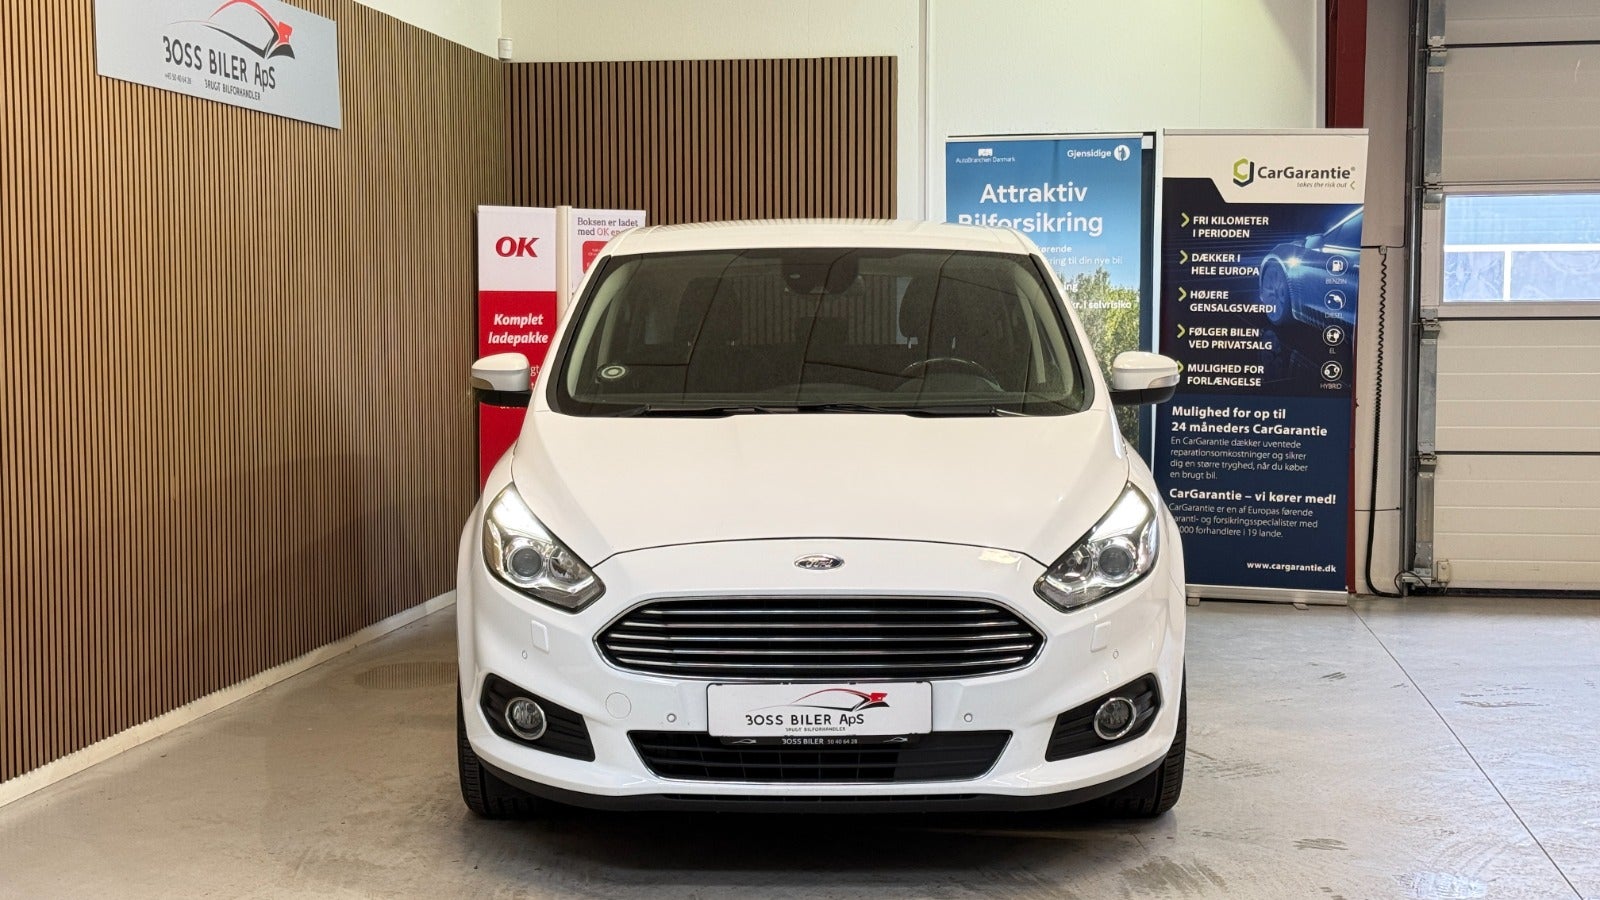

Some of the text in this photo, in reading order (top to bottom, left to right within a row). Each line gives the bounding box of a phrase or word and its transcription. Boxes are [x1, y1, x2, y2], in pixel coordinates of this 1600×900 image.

[209, 48, 248, 82] BILER
[254, 62, 276, 92] ApS
[223, 83, 260, 100] BILFORHANDLER
[1067, 148, 1112, 158] Gjensidige
[980, 182, 1088, 204] Attraktiv
[578, 217, 606, 226] Boksen
[619, 218, 638, 227] ladet
[1193, 216, 1269, 226] FRI KILOMETER
[1193, 229, 1250, 238] I PERIODEN
[496, 236, 540, 258] OK
[1068, 256, 1077, 264] til
[1079, 256, 1092, 264] din
[1094, 258, 1110, 266] nye
[1112, 256, 1122, 264] bil
[1192, 254, 1240, 263] DÆKKER I
[1191, 267, 1260, 276] HELE EUROPA
[1190, 290, 1229, 300] HØJERE
[1089, 300, 1131, 309] selvrisiko
[1190, 304, 1276, 313] GENSALGSVÆRDI
[494, 313, 544, 328] Komplet
[1189, 327, 1260, 337] FØLGER BILEN
[488, 332, 548, 346] ladepakke
[1189, 340, 1272, 350] VED PRIVATSALG
[1188, 364, 1264, 374] MULIGHED FOR
[1187, 376, 1261, 387] FORLÆNGELSE
[1172, 406, 1286, 421] Mulighed for op til
[1172, 422, 1328, 436] 24 måneders CarGarantie
[1183, 437, 1229, 446] CarGarantie
[1231, 439, 1260, 447] dækker
[1263, 440, 1301, 448] uventede
[1170, 449, 1306, 460] reparationsomkostninger og sikrer
[1170, 460, 1183, 469] dig
[1222, 461, 1255, 471] tryghed,
[1285, 463, 1308, 472] køber
[1182, 471, 1204, 480] brugt
[1170, 488, 1242, 501] CarGarantie
[1255, 492, 1266, 502] vi
[1269, 492, 1302, 503] kører
[1305, 494, 1336, 504] med!
[1169, 503, 1214, 513] CarGarantie
[1248, 506, 1279, 516] Europas
[1282, 508, 1313, 517] førende
[1201, 517, 1211, 525] og
[1213, 516, 1297, 527] forsikringsspecialister
[1300, 519, 1318, 528] med
[1196, 526, 1241, 536] forhandlere
[1247, 562, 1336, 572] www.cargarantie.dk
[791, 714, 831, 725] BILER
[839, 714, 864, 726] ApS
